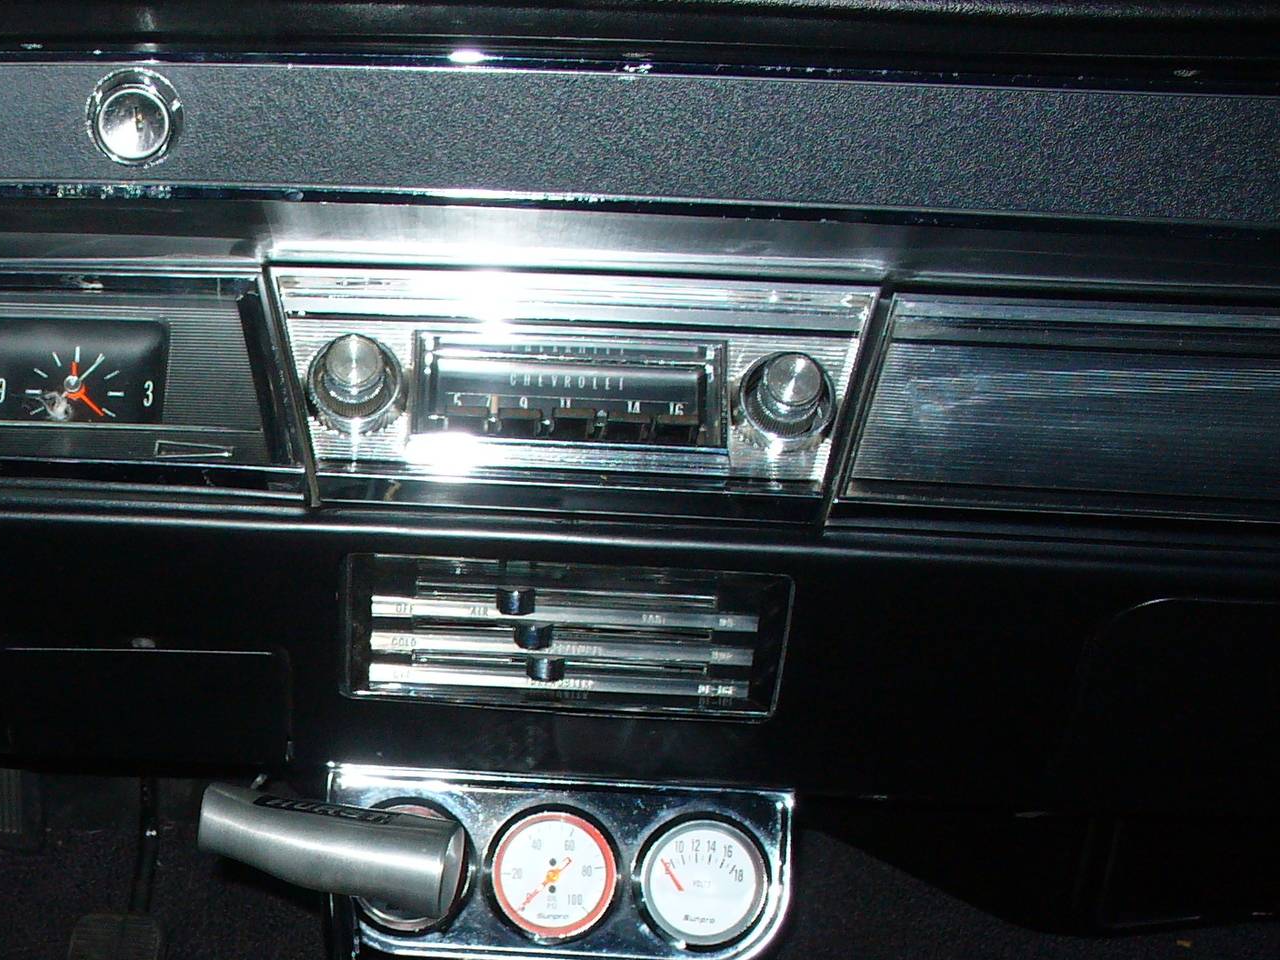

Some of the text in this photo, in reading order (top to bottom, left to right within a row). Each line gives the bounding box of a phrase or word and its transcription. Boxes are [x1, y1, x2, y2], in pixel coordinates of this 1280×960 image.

[510, 374, 625, 391] CHEVROLET
[143, 381, 154, 407] 3
[669, 402, 684, 416] 16
[531, 839, 542, 851] 40
[564, 839, 575, 851] 60
[675, 840, 685, 854] 10
[691, 839, 701, 852] 12
[707, 840, 717, 853] 14
[723, 845, 733, 858] 16
[512, 868, 523, 879] 20
[581, 865, 592, 877] 80
[734, 869, 744, 882] 18
[567, 894, 583, 906] 100
